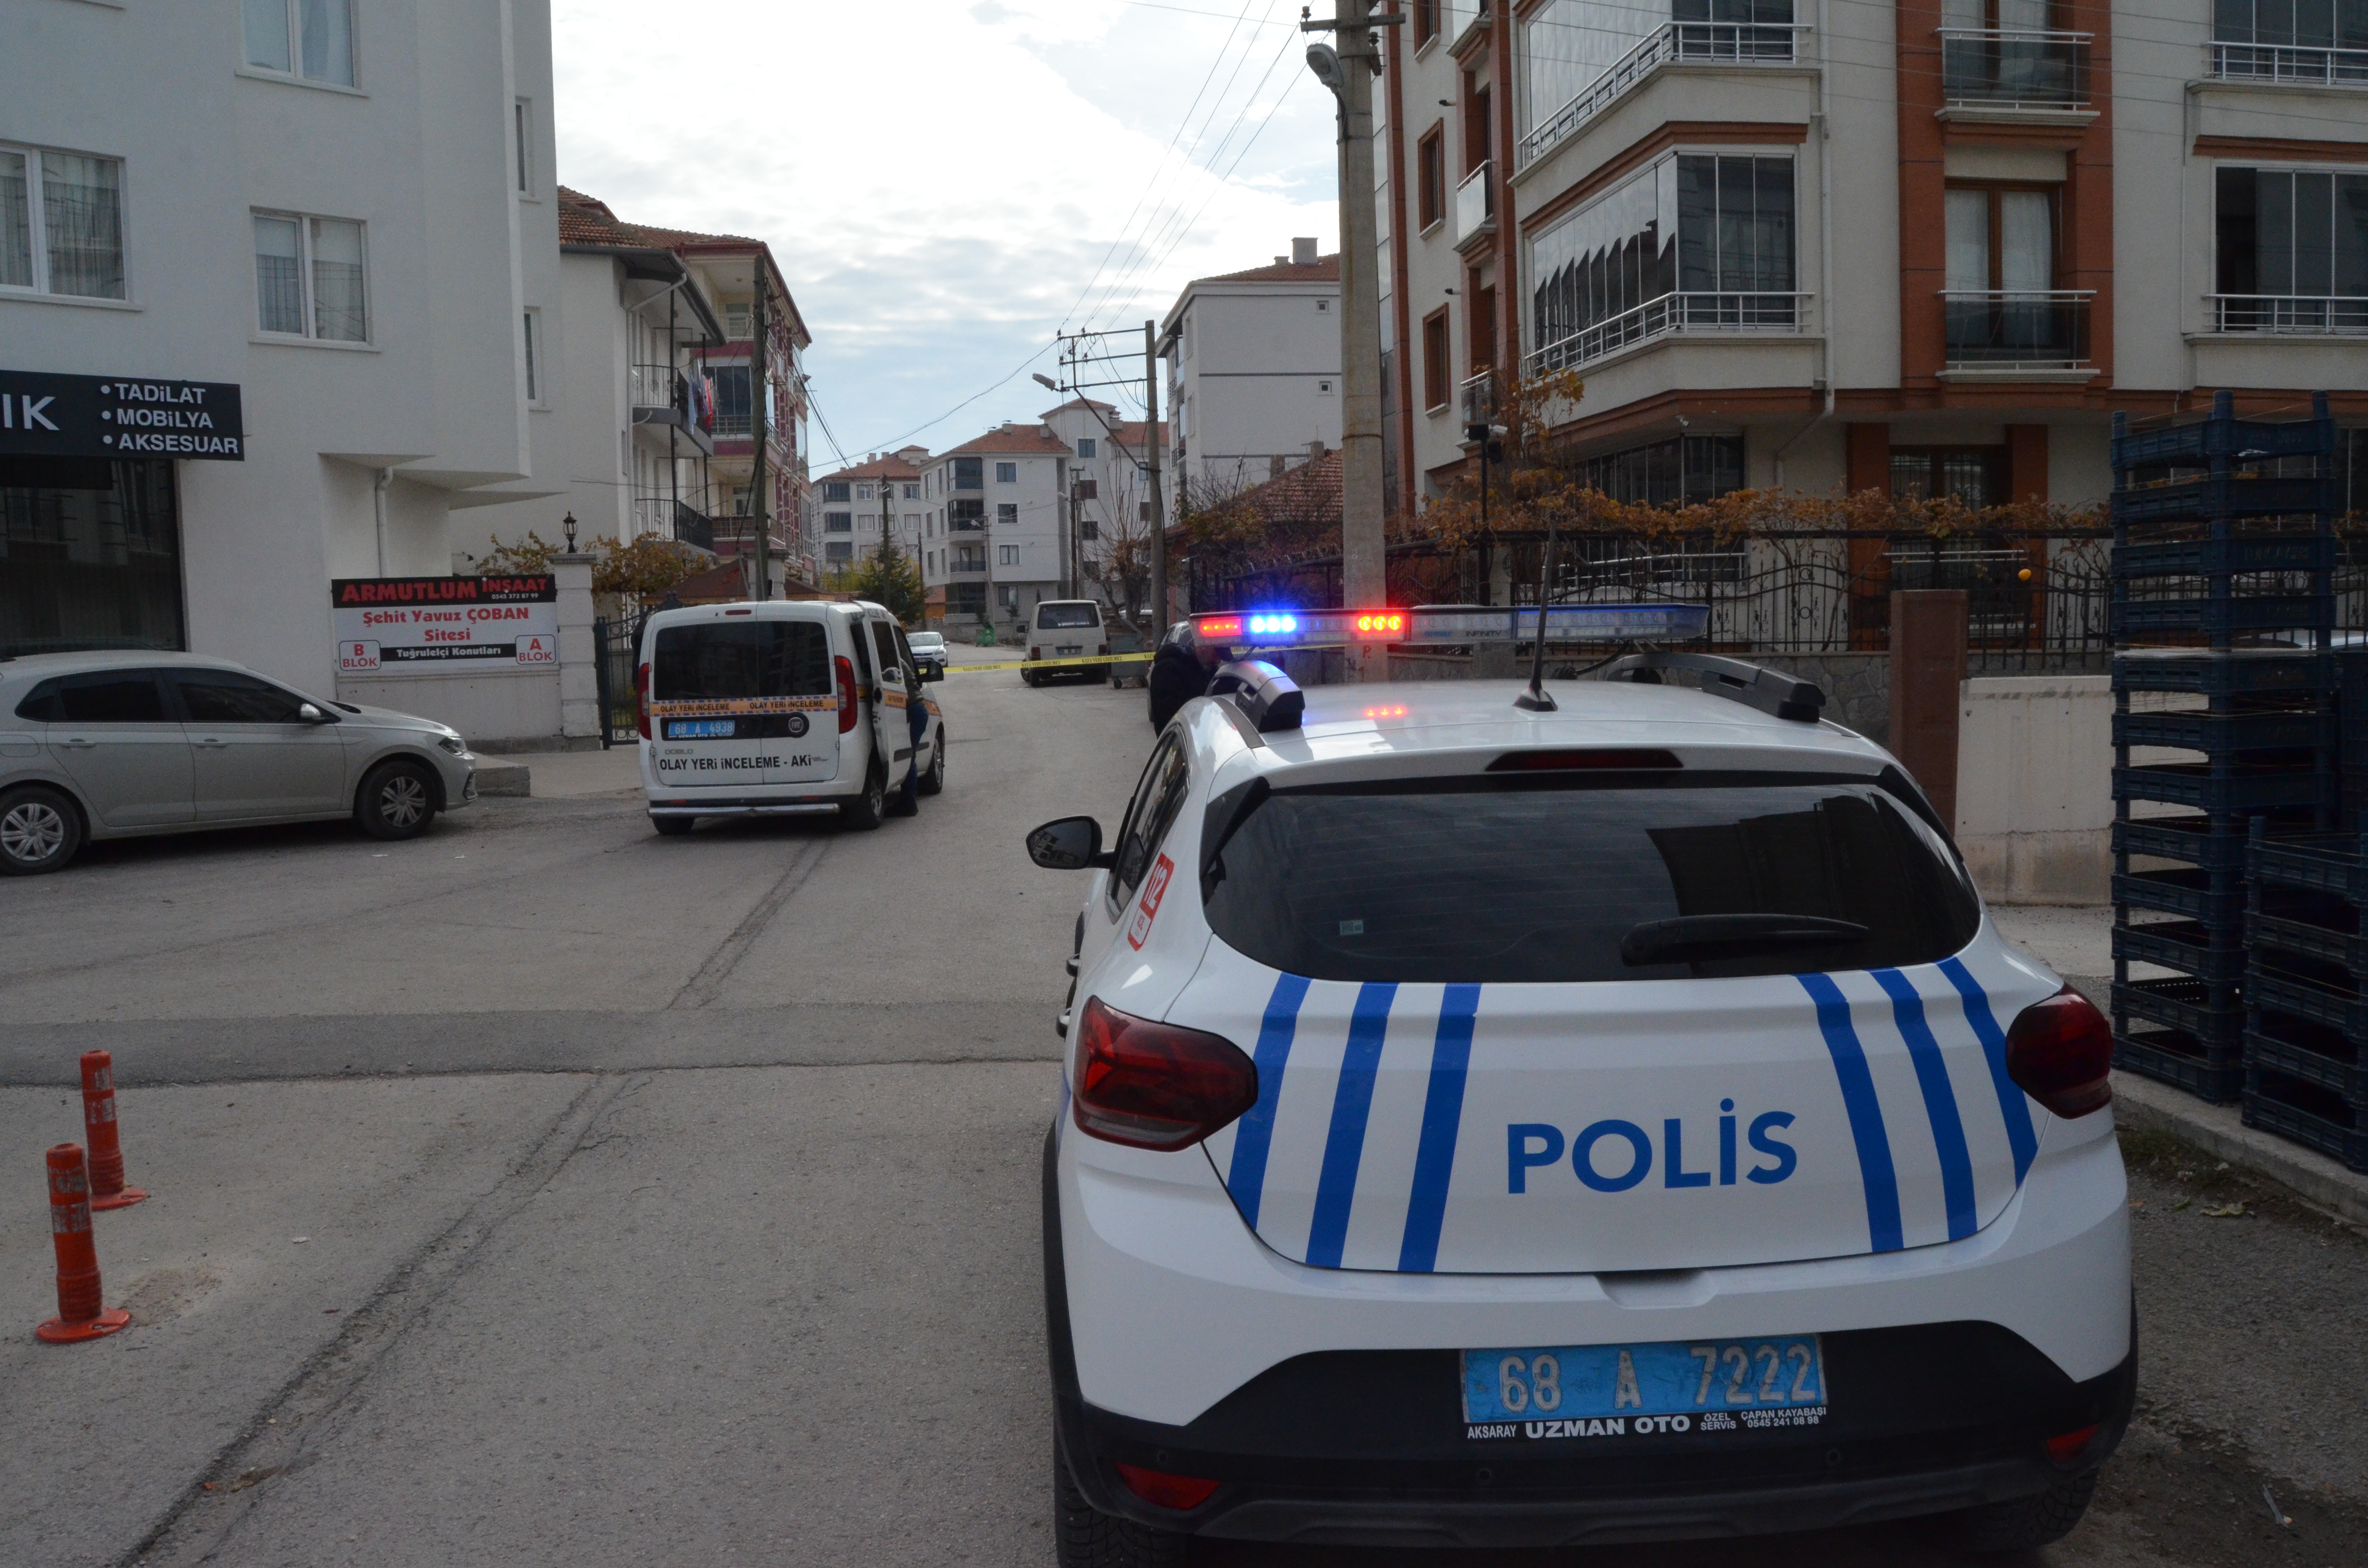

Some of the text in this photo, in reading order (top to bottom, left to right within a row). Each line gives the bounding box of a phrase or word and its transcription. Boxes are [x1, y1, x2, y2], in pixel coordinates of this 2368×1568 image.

[118, 433, 239, 453] AKSESUAR
[342, 581, 478, 601] ARMUTLUM
[363, 607, 529, 627] Şehit Yavuz ÇOBAN
[424, 627, 471, 642] Sitesi
[354, 644, 365, 656] B
[530, 638, 542, 650] A
[452, 646, 501, 656] Konutları
[519, 651, 552, 662] BLOK
[343, 657, 378, 667] BLOK
[675, 722, 733, 734] 68 A 4938
[660, 759, 688, 771] OLAY
[1144, 863, 1168, 910] 112
[1499, 1343, 1817, 1413] 68 A 7222
[1704, 1412, 1731, 1422] ÖZEL
[1741, 1407, 1826, 1421] ÇAPAN KAYABAŞI
[1468, 1415, 1690, 1439] AKSARAY UZMAN OTO
[1747, 1416, 1819, 1428] 0545 241 08 98
